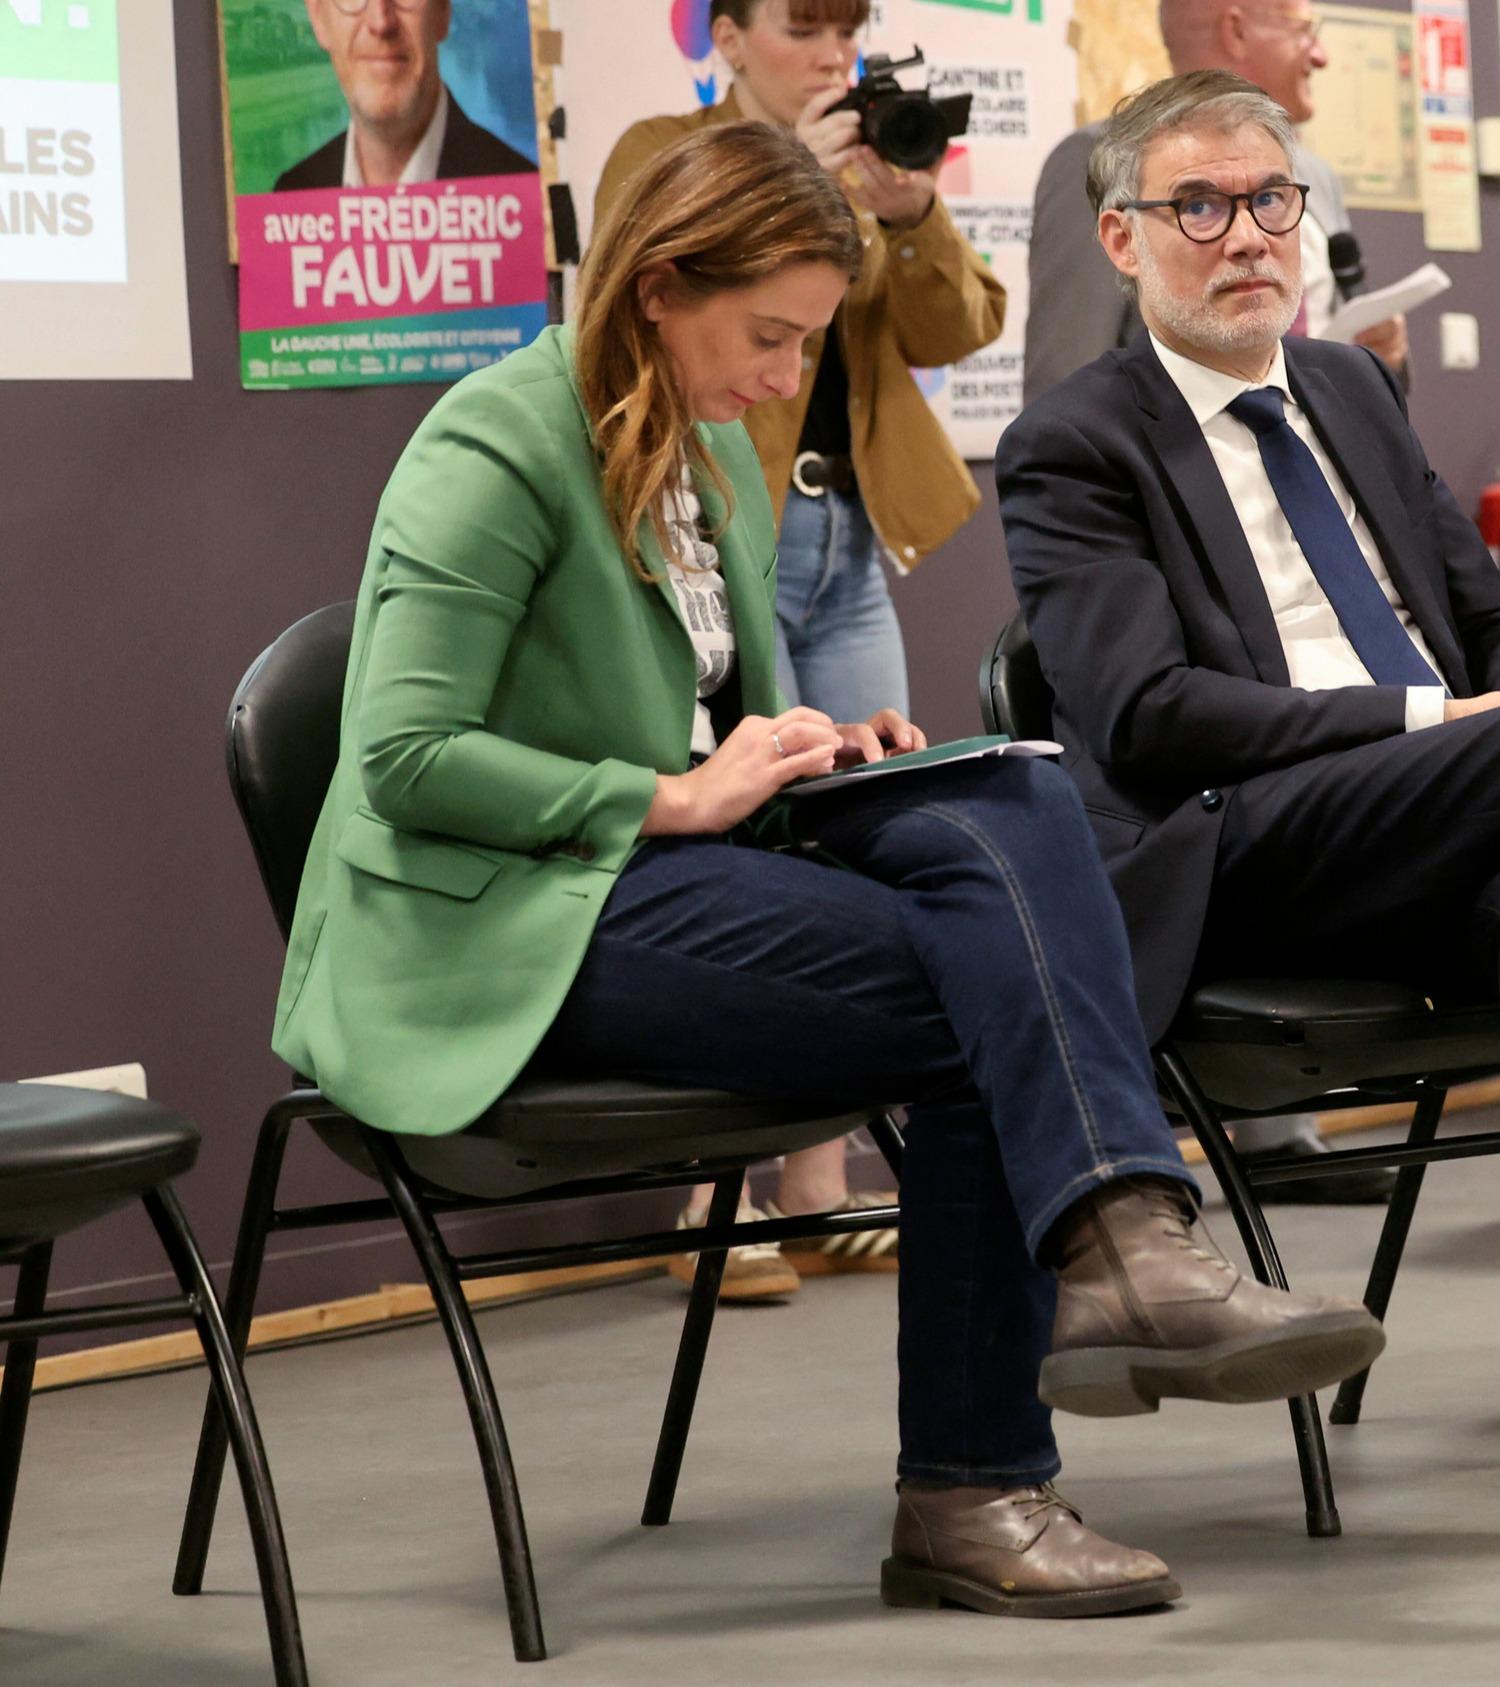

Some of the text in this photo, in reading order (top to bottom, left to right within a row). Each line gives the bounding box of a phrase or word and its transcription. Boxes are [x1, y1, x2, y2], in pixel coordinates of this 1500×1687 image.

[263, 184, 523, 243] avec FRÉDÉRIC
[290, 242, 503, 309] FAUVET
